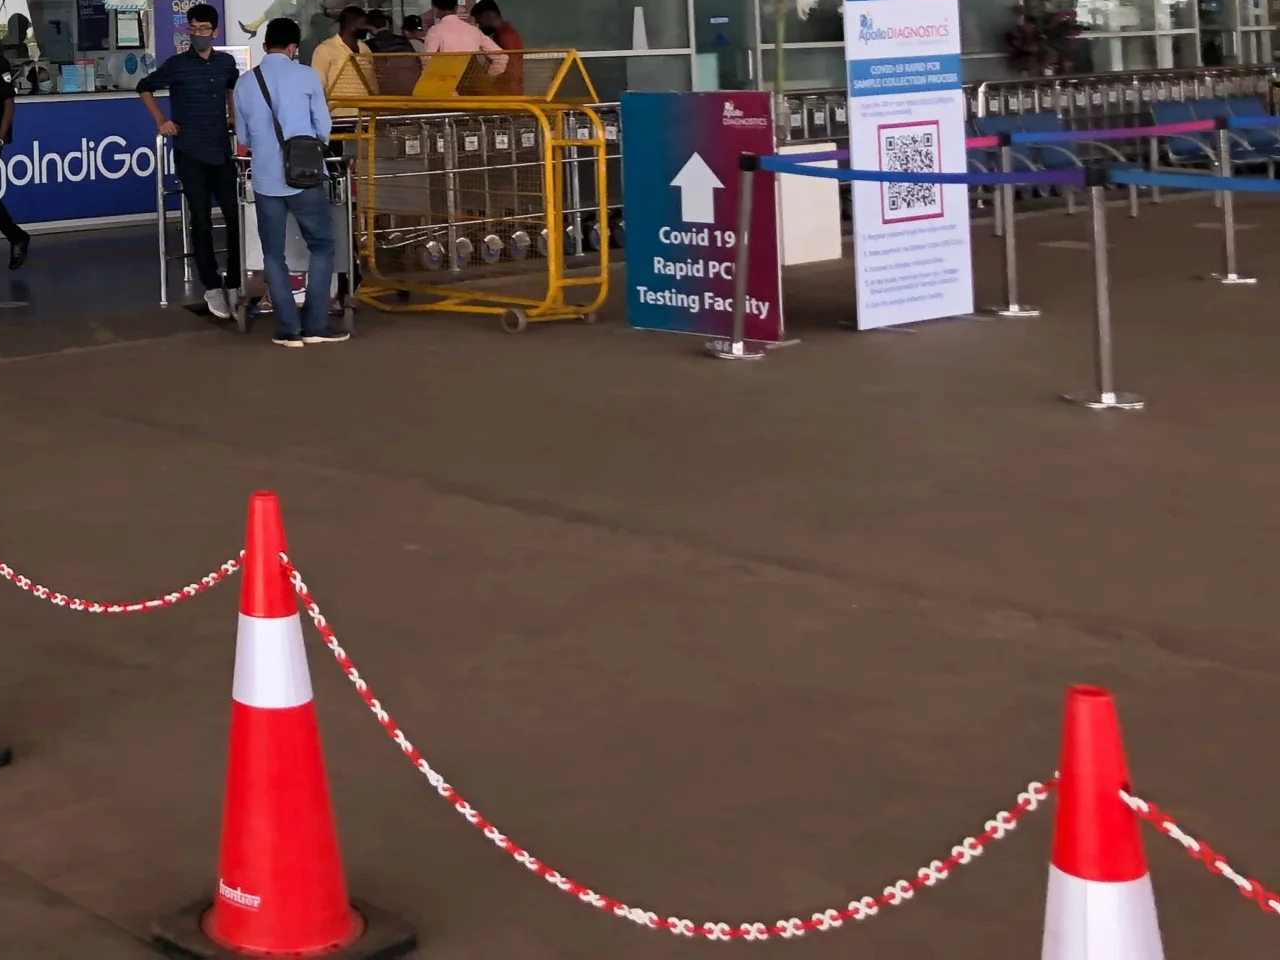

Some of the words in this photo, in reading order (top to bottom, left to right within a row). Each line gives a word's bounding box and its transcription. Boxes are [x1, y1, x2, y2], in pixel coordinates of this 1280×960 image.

[858, 27, 887, 46] Apollo
[887, 24, 949, 39] DIAGNOSTICS
[870, 63, 904, 75] COVID-19
[882, 75, 926, 87] COLLECTION
[659, 226, 709, 246] Covid
[714, 230, 736, 248] 19
[654, 256, 704, 280] Rapid
[708, 261, 735, 280] PC
[636, 285, 700, 313] Testing
[704, 292, 770, 319] Facity
